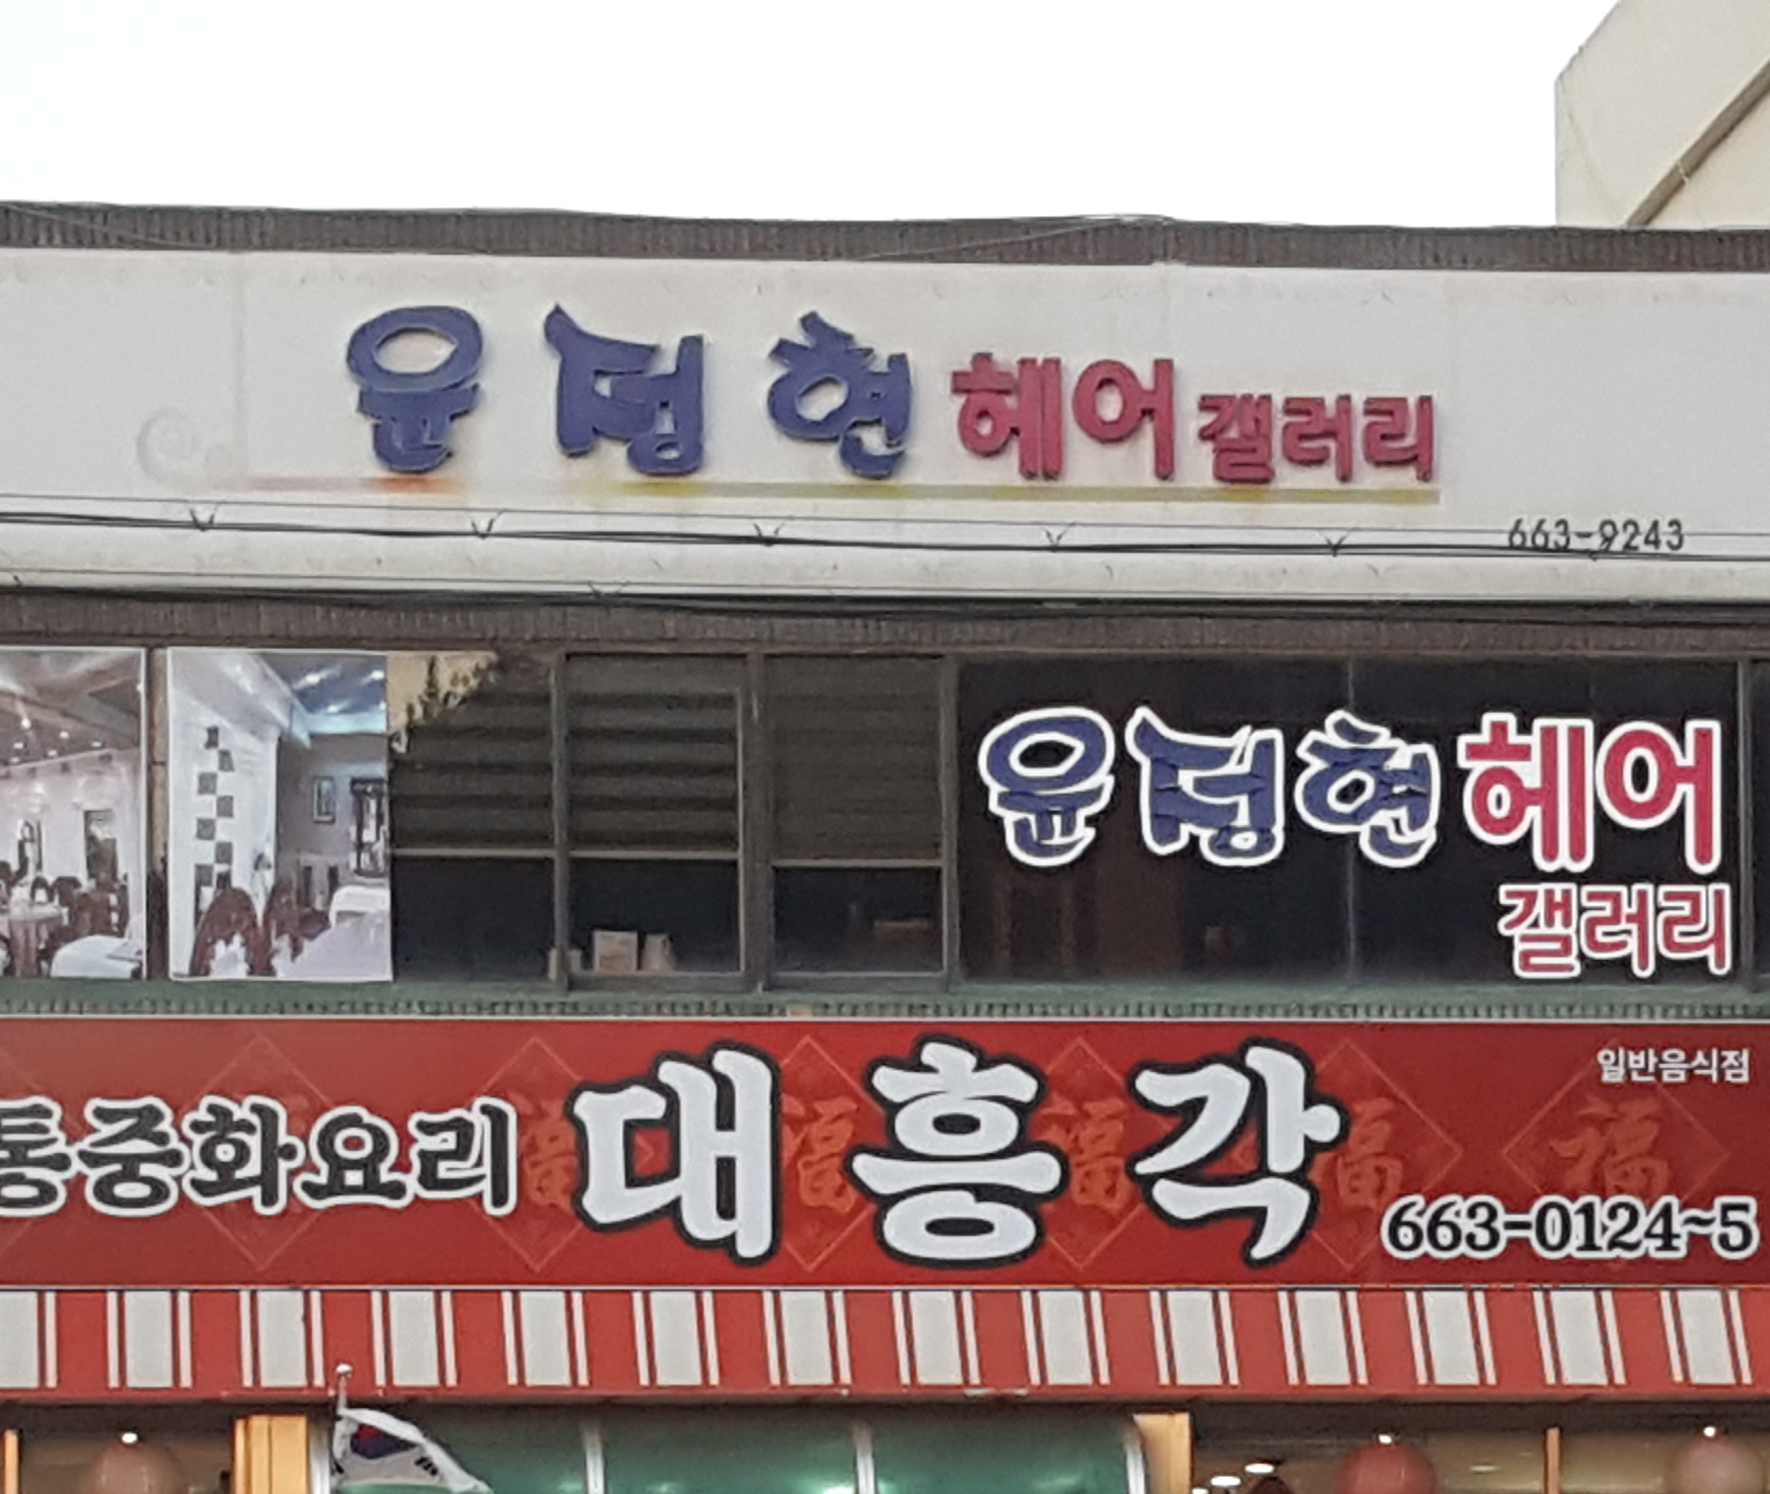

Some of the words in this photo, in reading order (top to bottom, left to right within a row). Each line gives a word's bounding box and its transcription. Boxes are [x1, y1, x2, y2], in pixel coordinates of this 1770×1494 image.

[951, 350, 1176, 480] 헤어
[1196, 392, 1436, 486] 갤러리
[1507, 518, 1687, 556] 663-9243
[1460, 713, 1724, 874] 헤어
[1498, 884, 1732, 979] 갤러리
[1595, 1047, 1751, 1085] 일반음식점
[567, 1034, 1349, 1267] 대흥각
[1380, 1192, 1760, 1262] 663-0124~5
